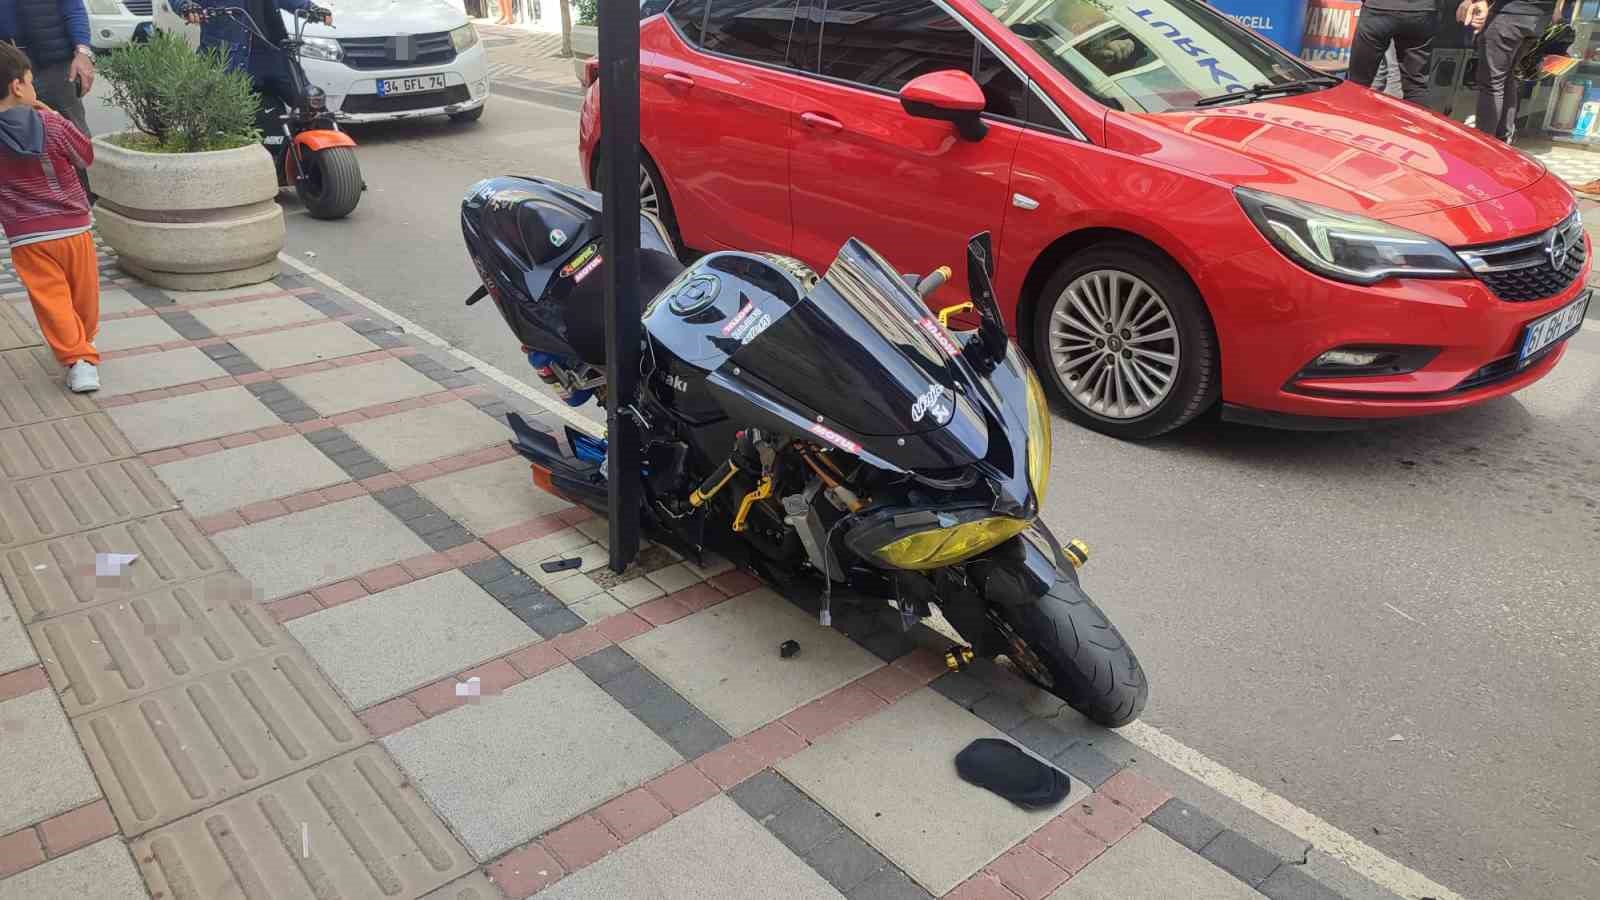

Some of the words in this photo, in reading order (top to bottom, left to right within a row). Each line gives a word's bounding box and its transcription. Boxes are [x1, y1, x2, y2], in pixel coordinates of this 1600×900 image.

[384, 80, 399, 93] 34
[404, 79, 425, 91] GFL
[430, 77, 443, 89] 74
